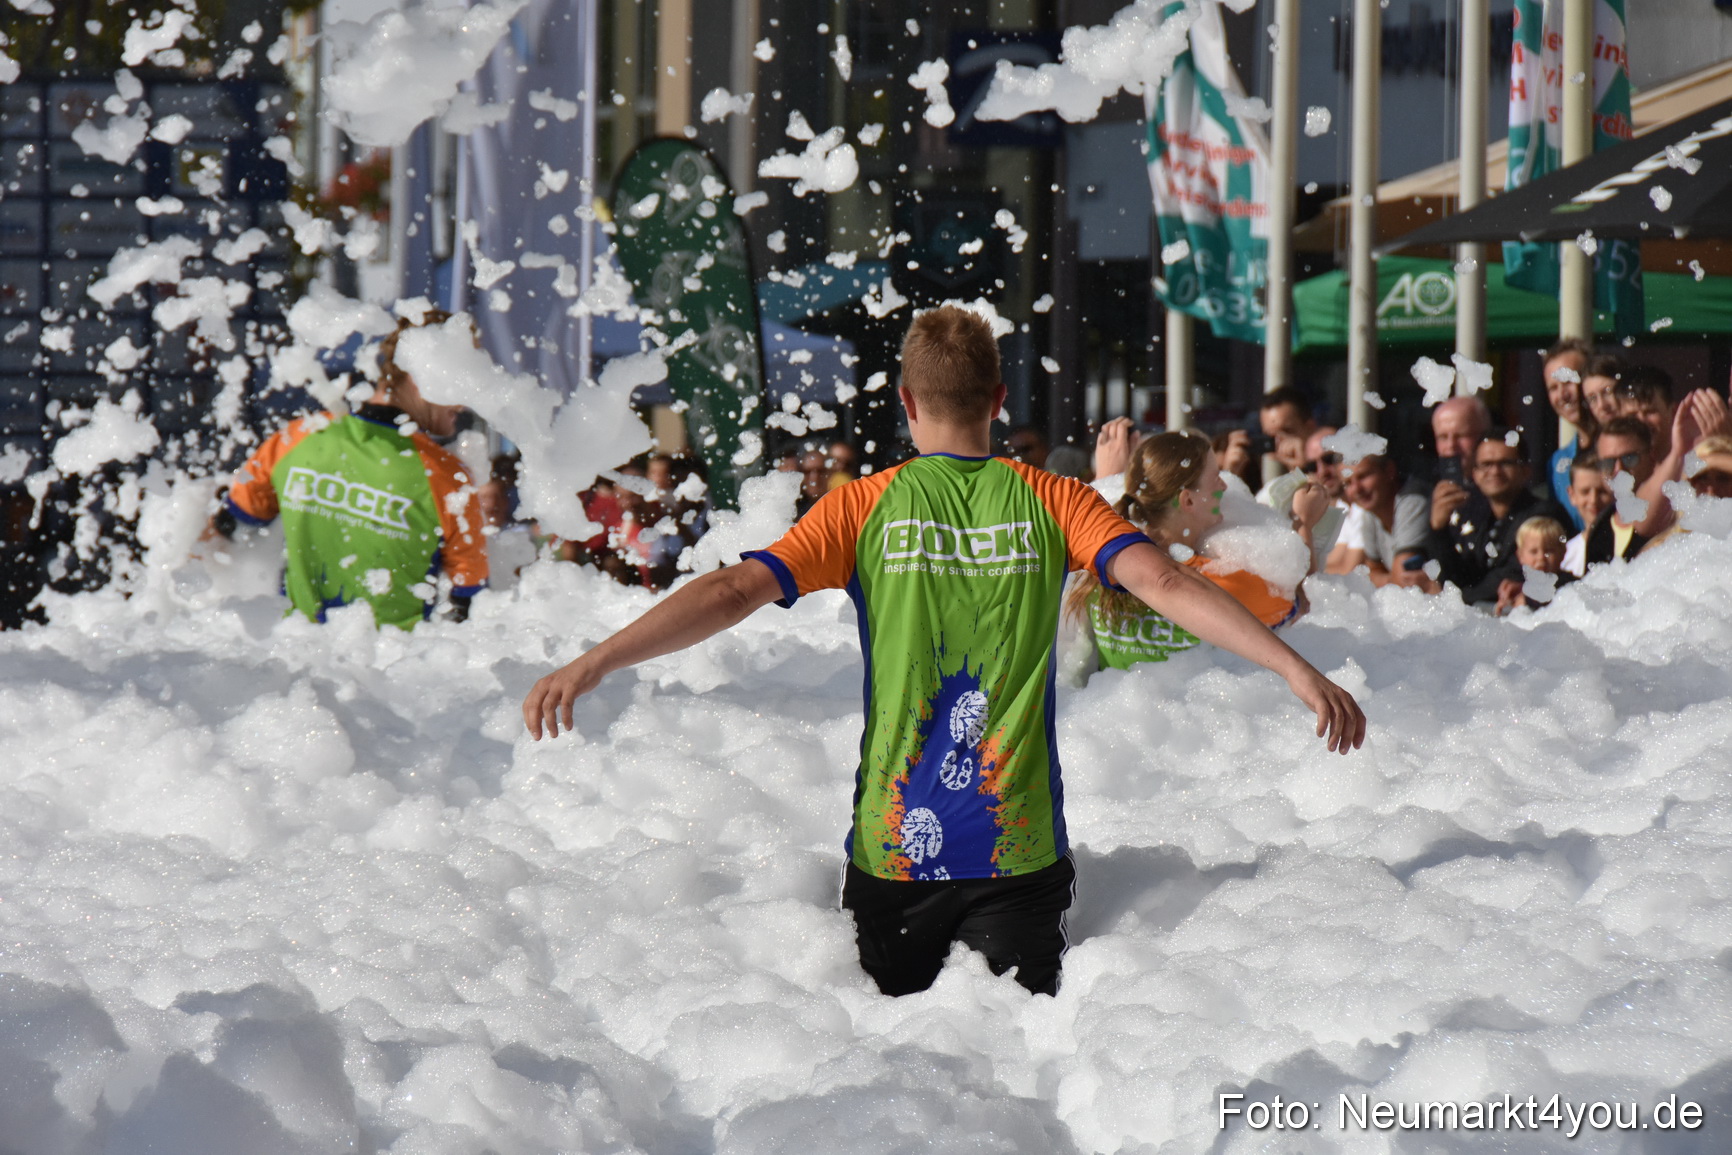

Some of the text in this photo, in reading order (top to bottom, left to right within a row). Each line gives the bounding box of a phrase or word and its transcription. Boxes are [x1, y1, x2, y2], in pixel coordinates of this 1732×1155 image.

[1375, 271, 1456, 316] AO
[283, 466, 414, 530] BOCK
[883, 519, 1039, 564] BOCK
[884, 561, 1041, 577] inspired by smart concepts
[1116, 643, 1128, 654] by
